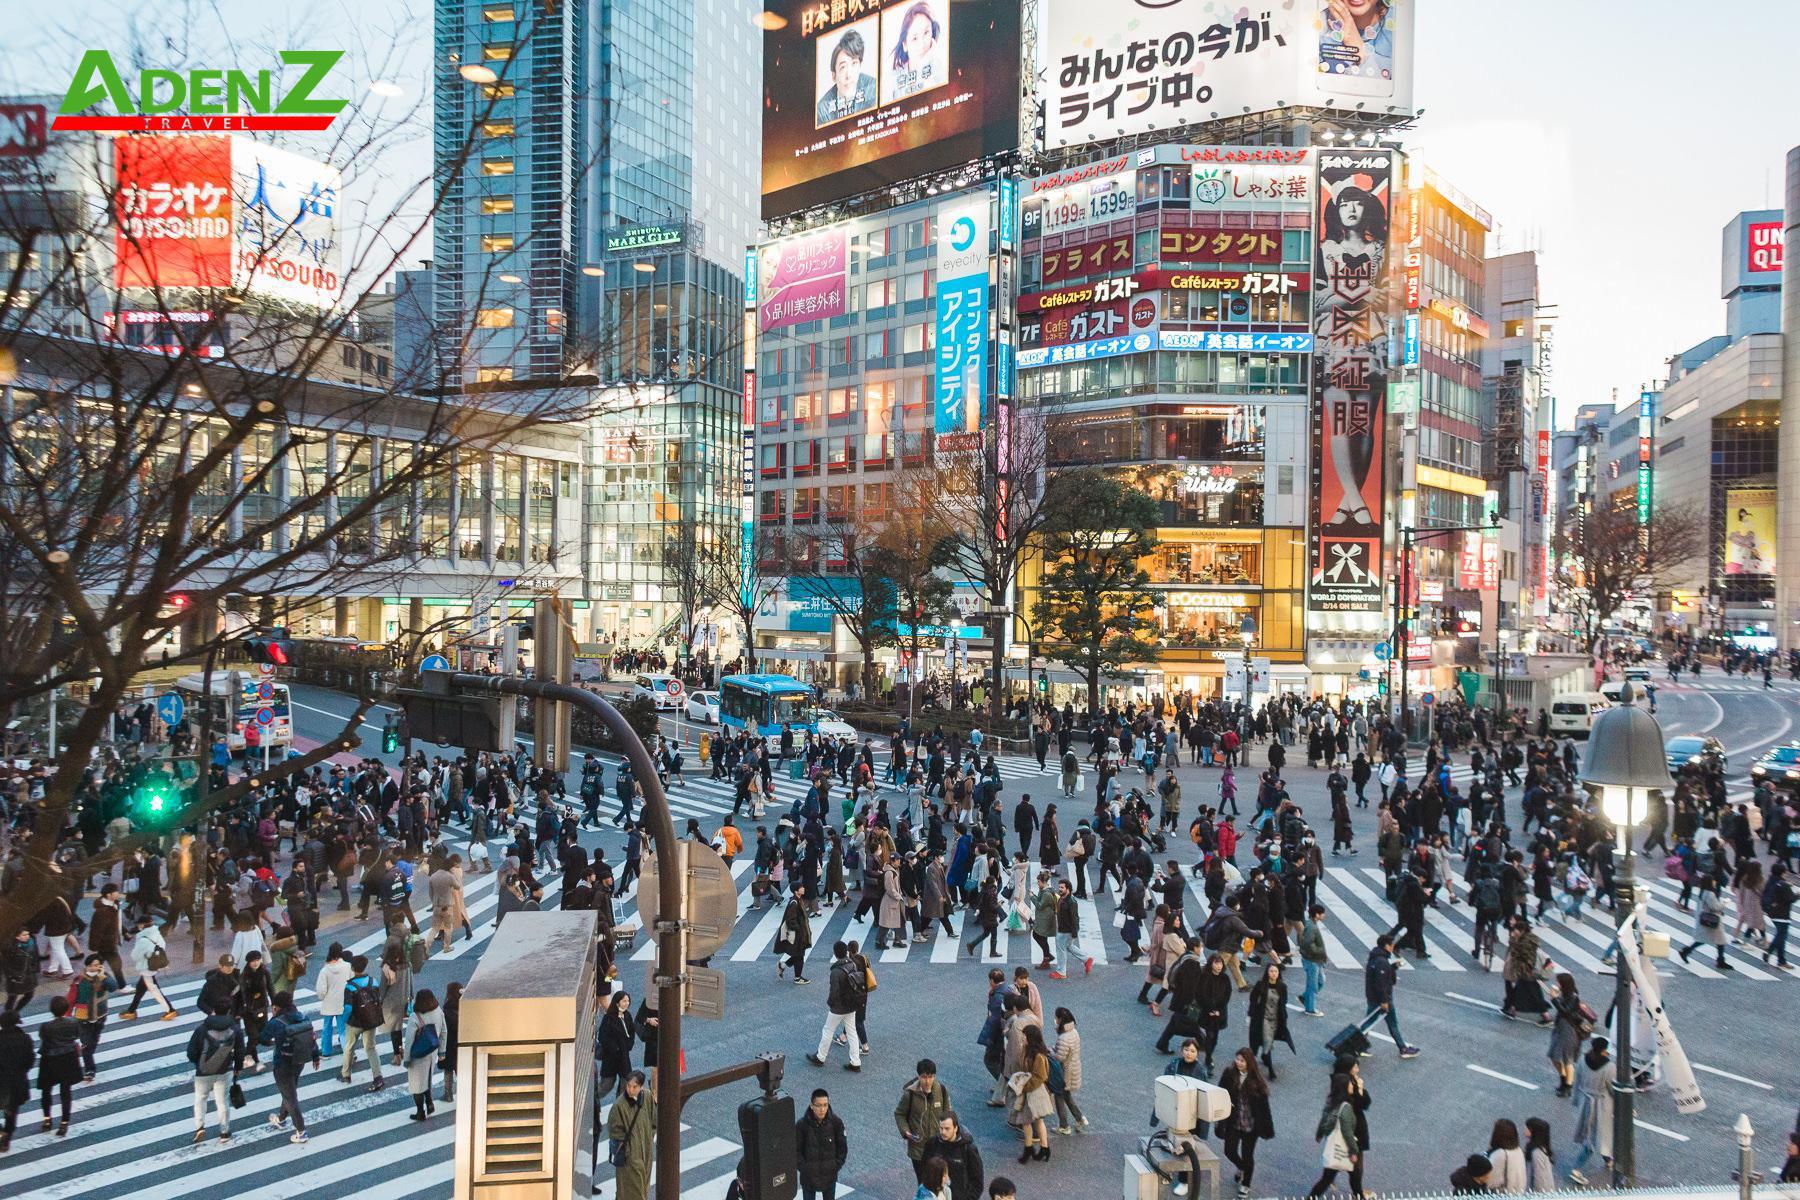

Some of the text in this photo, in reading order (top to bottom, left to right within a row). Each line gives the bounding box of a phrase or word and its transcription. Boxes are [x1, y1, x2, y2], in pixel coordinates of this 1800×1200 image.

[1060, 12, 1287, 88] みんなの今が、
[1060, 73, 1213, 128] ライブ中。
[1181, 147, 1308, 163] しゃぶしゃぶバイキング
[1031, 155, 1129, 192] しゃぶしゃぶバイキング
[1233, 175, 1307, 199] しゃぶ葉
[121, 182, 228, 215] カラオケ
[1024, 208, 1041, 228] 9F
[608, 231, 679, 248] MARK CITY
[625, 226, 661, 237] SHIBUYA
[1162, 232, 1279, 255] コンタクト
[797, 255, 837, 276] クリニック
[943, 252, 982, 271] eyecity
[1044, 239, 1131, 276] プライス
[1094, 277, 1139, 303] ガスト
[1242, 273, 1298, 294] ガスト
[772, 289, 841, 321] 品川美容外科
[1134, 311, 1153, 321] ガスト
[1021, 324, 1040, 342] 7F
[1070, 309, 1124, 341] ガスト
[1052, 339, 1132, 363] 英会話イーオン
[1164, 334, 1200, 347] AEON
[1207, 333, 1310, 350] 英会話イーオン
[941, 291, 963, 421] アイシティ
[1310, 593, 1381, 602] WORLD DOMINATION
[1339, 602, 1350, 610] ON
[1351, 602, 1369, 610] SALE
